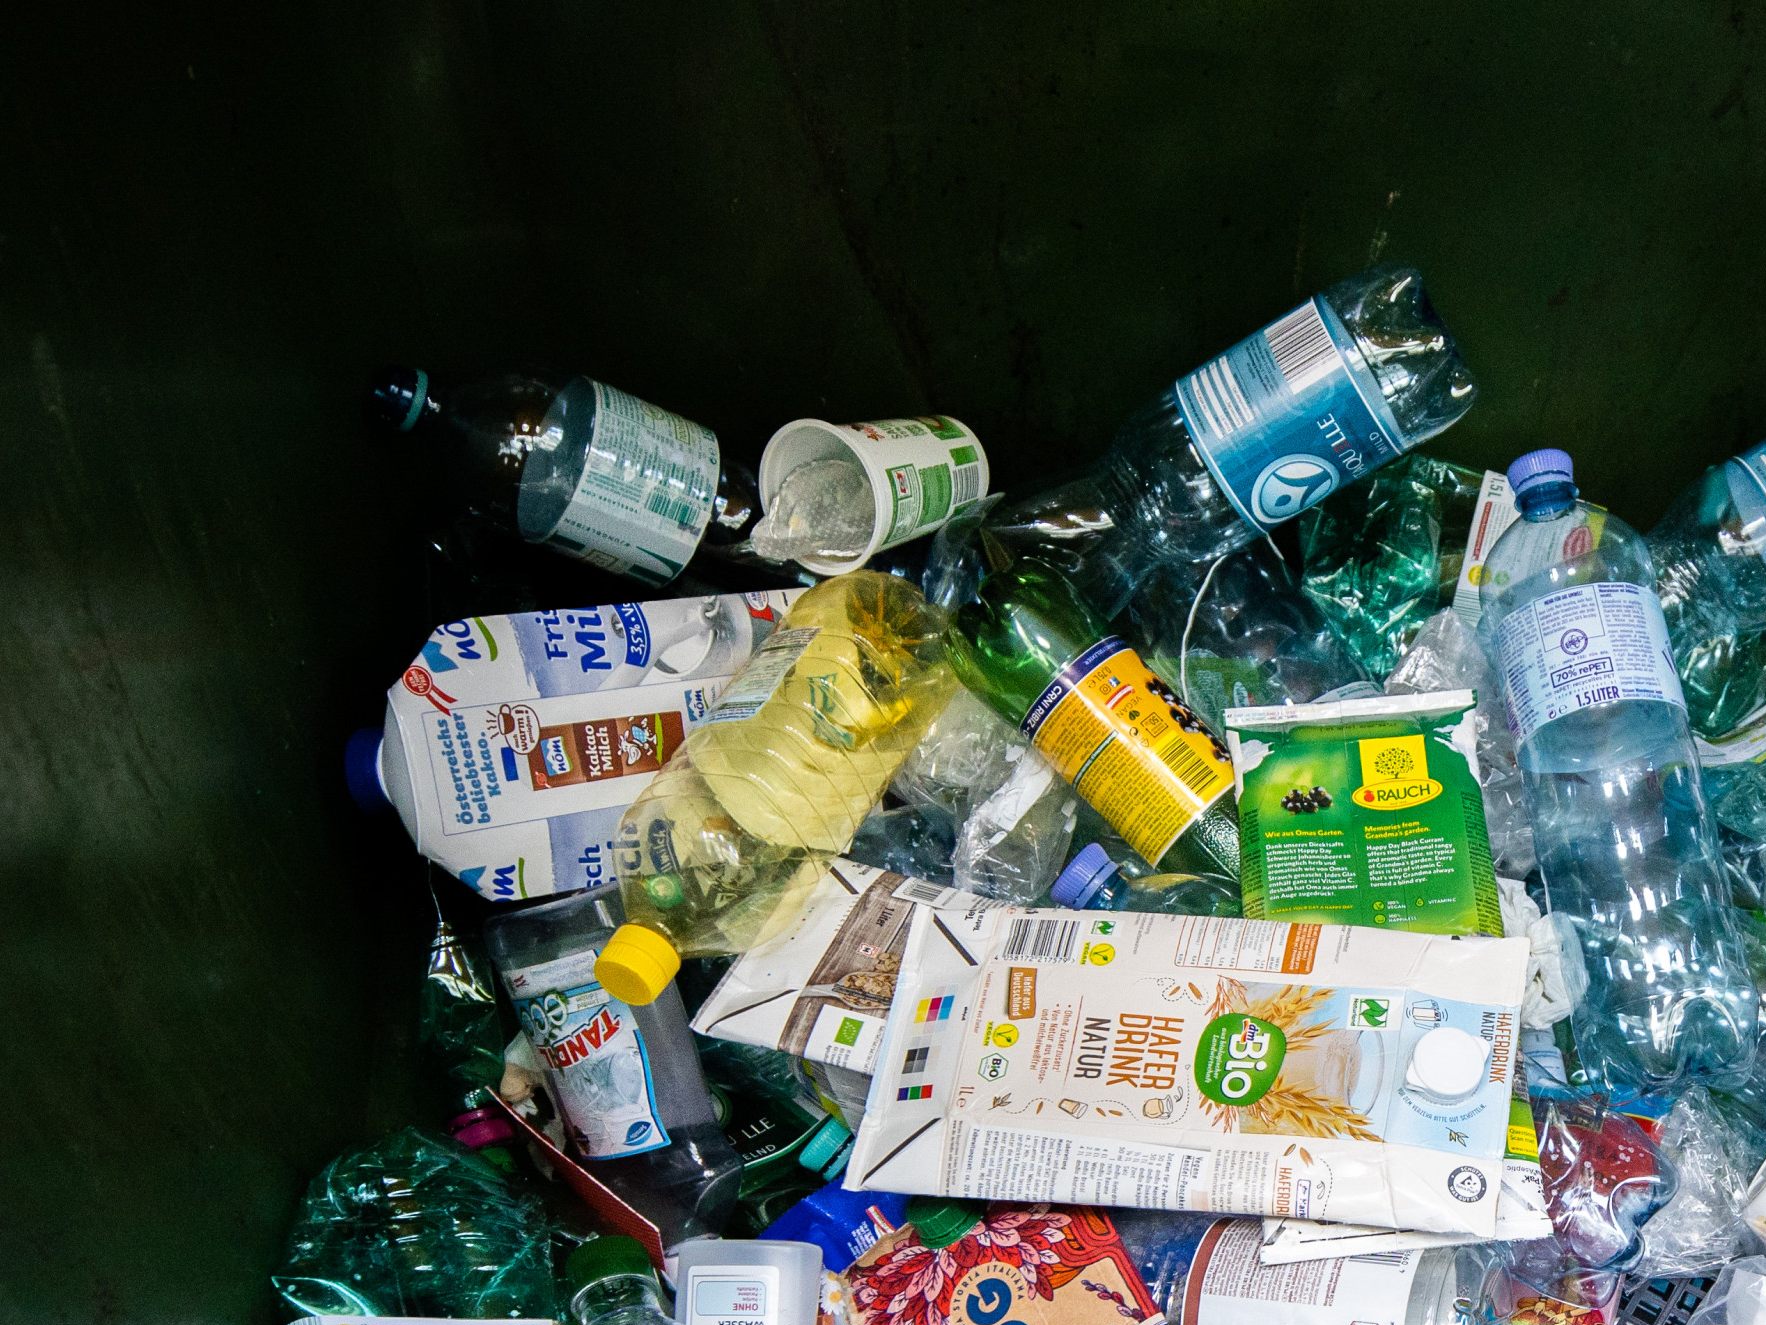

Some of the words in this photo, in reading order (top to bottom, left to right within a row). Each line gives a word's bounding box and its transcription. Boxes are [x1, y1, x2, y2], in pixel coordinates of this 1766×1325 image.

[1555, 668, 1578, 681] 70%
[1578, 661, 1608, 675] rePET
[1041, 684, 1063, 707] CRNI
[1592, 686, 1620, 701] LITER
[1025, 704, 1046, 727] RIBIZ
[584, 724, 602, 778] Kakao
[597, 726, 614, 771] Milch
[437, 718, 474, 825] Österreichs
[452, 713, 491, 824] beliebtester
[477, 731, 501, 798] Kakao.
[1377, 784, 1430, 802] RAUCH
[1295, 829, 1315, 837] Omas
[1364, 824, 1397, 832] Memories
[1365, 830, 1402, 839] Grandma's
[1403, 826, 1429, 836] garden.
[1366, 843, 1387, 851] Happy
[1080, 941, 1090, 965] VEGAN
[1012, 972, 1022, 1016] Deutschland
[1023, 976, 1032, 995] Hafer
[1048, 1008, 1060, 1022] Von
[1058, 1008, 1073, 1028] Ohne
[983, 1021, 993, 1047] VEGAN
[1042, 1021, 1057, 1043] Natur
[1040, 1043, 1051, 1057] aus
[1072, 1015, 1108, 1080] NATUR
[1105, 1011, 1150, 1090] DRINK
[1141, 1015, 1183, 1091] HAFER
[1204, 1033, 1219, 1083] Landwirtschaft
[1489, 1012, 1511, 1085] HAFERDRINK
[1034, 1056, 1050, 1084] laktose-
[1225, 1033, 1270, 1101] Bio
[1191, 1156, 1202, 1179] Vegane
[1177, 1155, 1192, 1209] Mandel-Pancakes
[732, 1302, 758, 1311] OHNE
